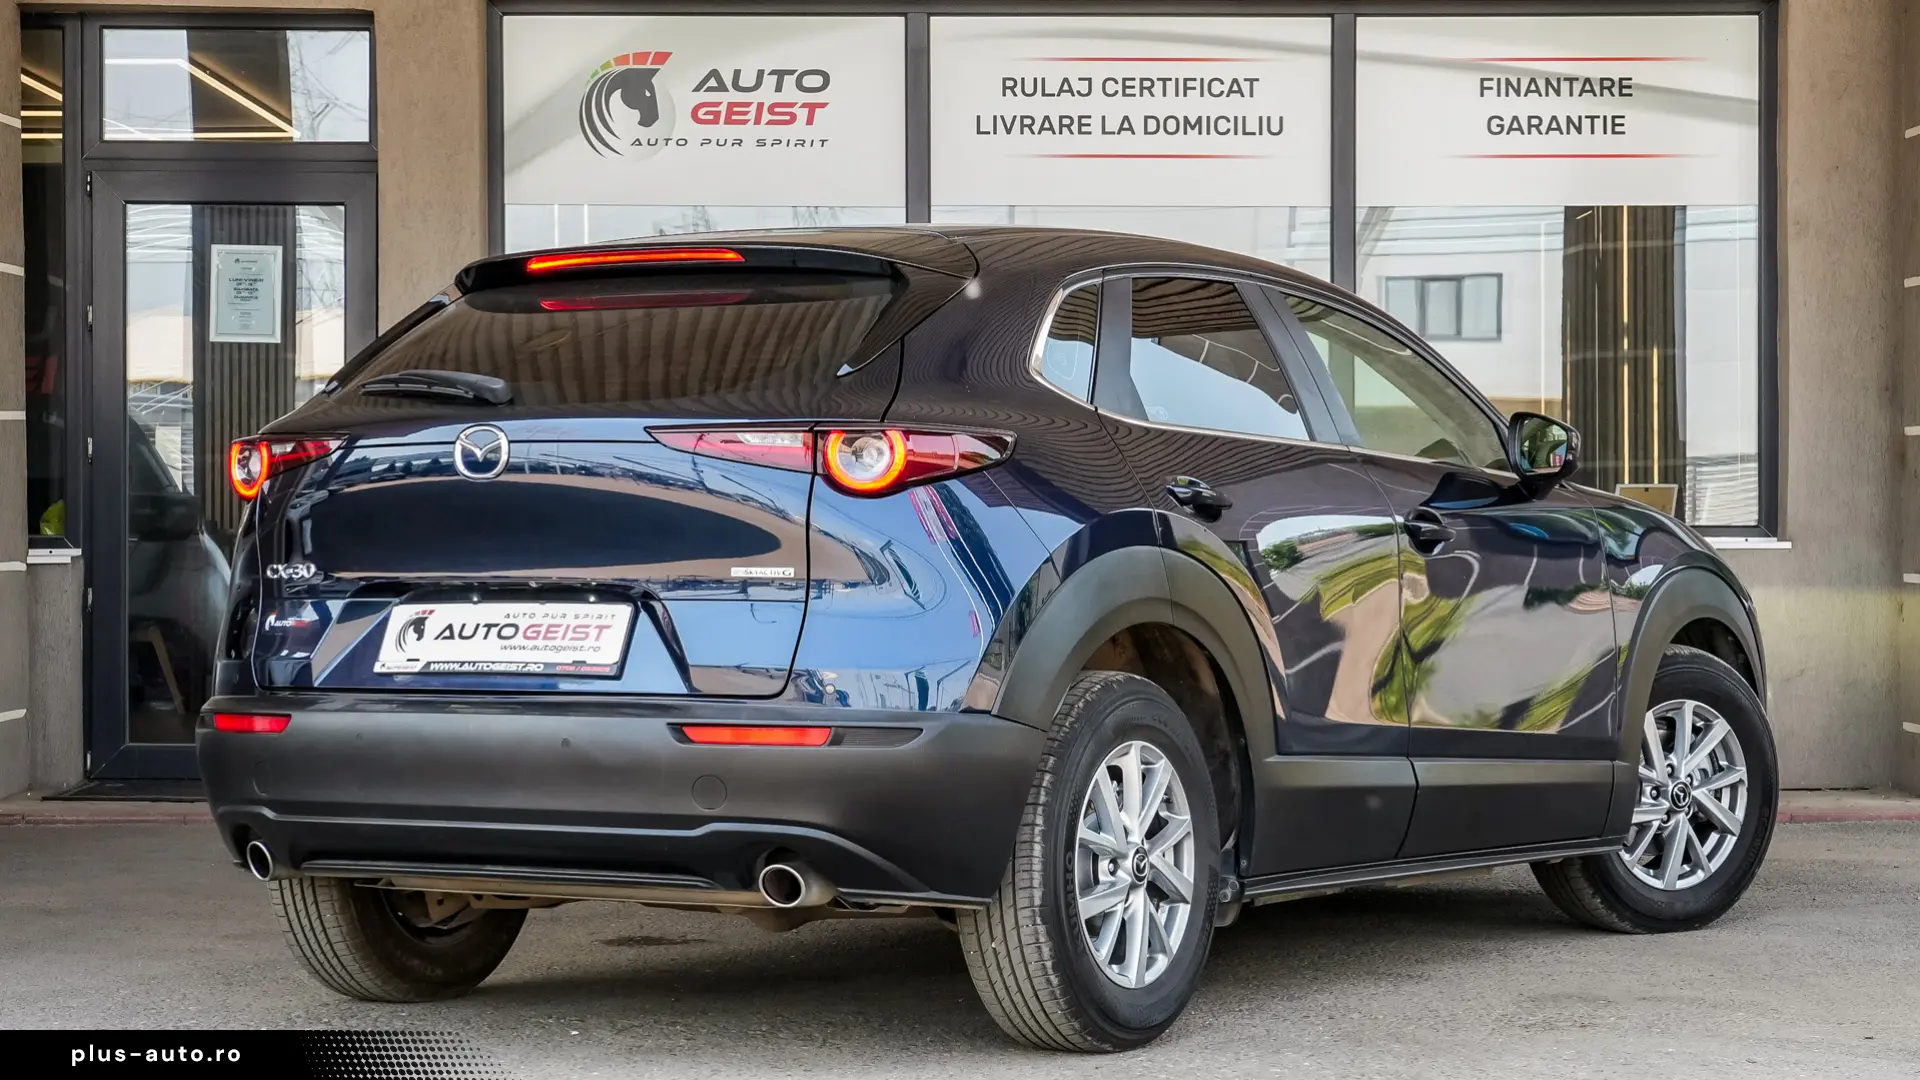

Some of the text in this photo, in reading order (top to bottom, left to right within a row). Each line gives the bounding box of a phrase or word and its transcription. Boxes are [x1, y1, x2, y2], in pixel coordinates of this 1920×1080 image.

[691, 68, 831, 93] AUTO
[1001, 77, 1260, 98] RULAJ CERTIFICAT
[1479, 77, 1633, 98] FINANTARE
[690, 101, 830, 126] GEIST
[976, 114, 1284, 136] LIVRARE LA DOMICILIU
[1486, 114, 1626, 136] GARANTIE
[630, 137, 830, 148] AUTO PUR SPIRIT
[266, 562, 317, 579] CX-30
[503, 612, 536, 620] AUTO
[542, 612, 568, 620] PUR
[500, 643, 601, 653] www.autogeist.ro
[429, 661, 544, 672] WWW.AUTOGEIST.RO
